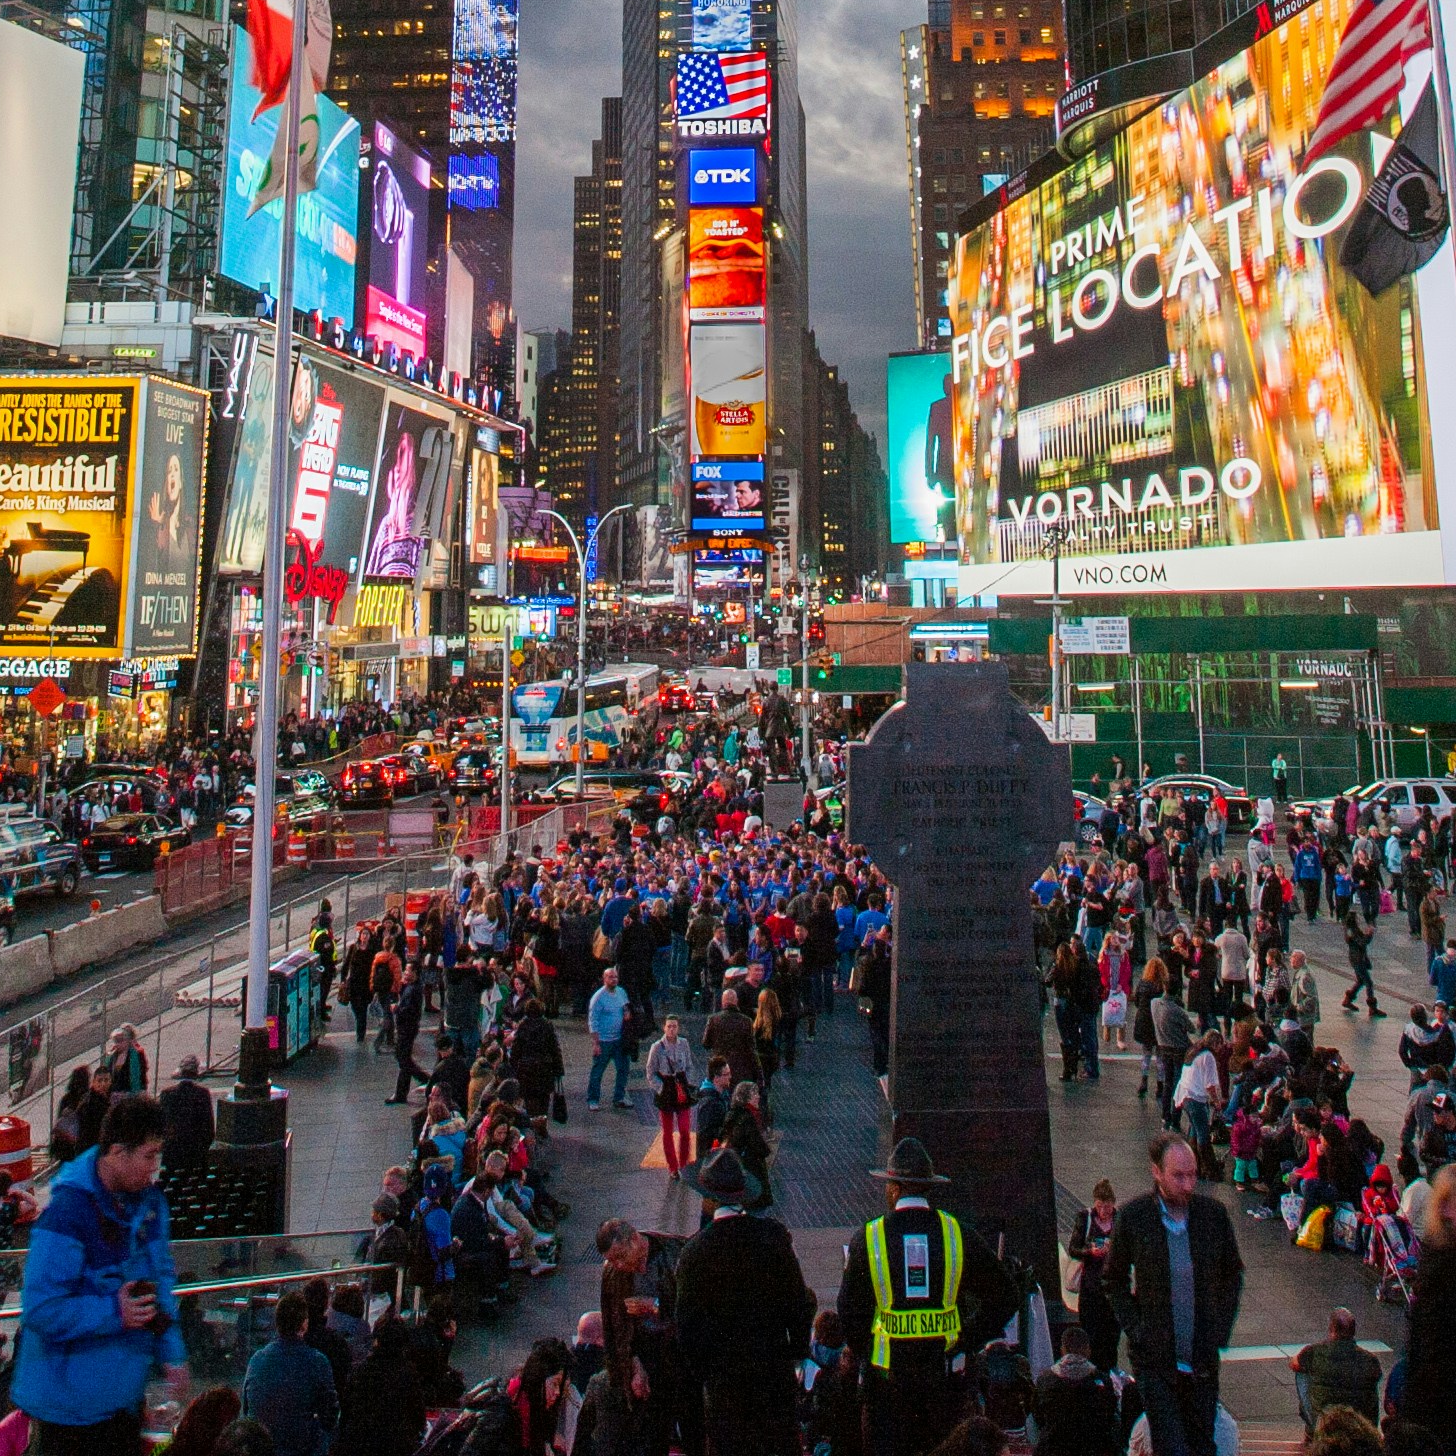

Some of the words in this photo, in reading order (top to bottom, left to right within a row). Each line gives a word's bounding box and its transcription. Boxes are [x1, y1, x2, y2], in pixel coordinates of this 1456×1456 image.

[1061, 79, 1099, 109] MARRIOTT
[1062, 96, 1095, 122] MARQUIS
[679, 121, 765, 136] TOSHIBA
[706, 167, 751, 183] TDK
[1051, 195, 1145, 275] PRIME
[117, 348, 153, 356] LAMAR
[952, 304, 1035, 385] FICE
[21, 394, 46, 407] JOINS
[46, 394, 61, 407] THE
[63, 394, 92, 408] RANKS
[93, 394, 105, 408] OF
[105, 394, 122, 408] THE
[154, 391, 164, 403] SEE
[165, 425, 184, 444] LIVE
[308, 403, 341, 447] BIG
[302, 444, 334, 474] HERO
[696, 466, 722, 478] FOX
[37, 495, 65, 513] King
[67, 495, 115, 511] Musical
[293, 471, 331, 539] 6
[1007, 457, 1261, 533] VORNADO
[1127, 514, 1212, 535] TRUST
[145, 572, 162, 586] IDINA
[164, 572, 186, 586] MENZEL
[1074, 563, 1167, 585] VNO.COM
[140, 590, 189, 628] IF/THEN
[355, 585, 404, 627] FOREVER
[894, 778, 955, 795] FRANCIS
[880, 1312, 917, 1335] PUBLIC
[920, 1310, 958, 1334] SAFETY
